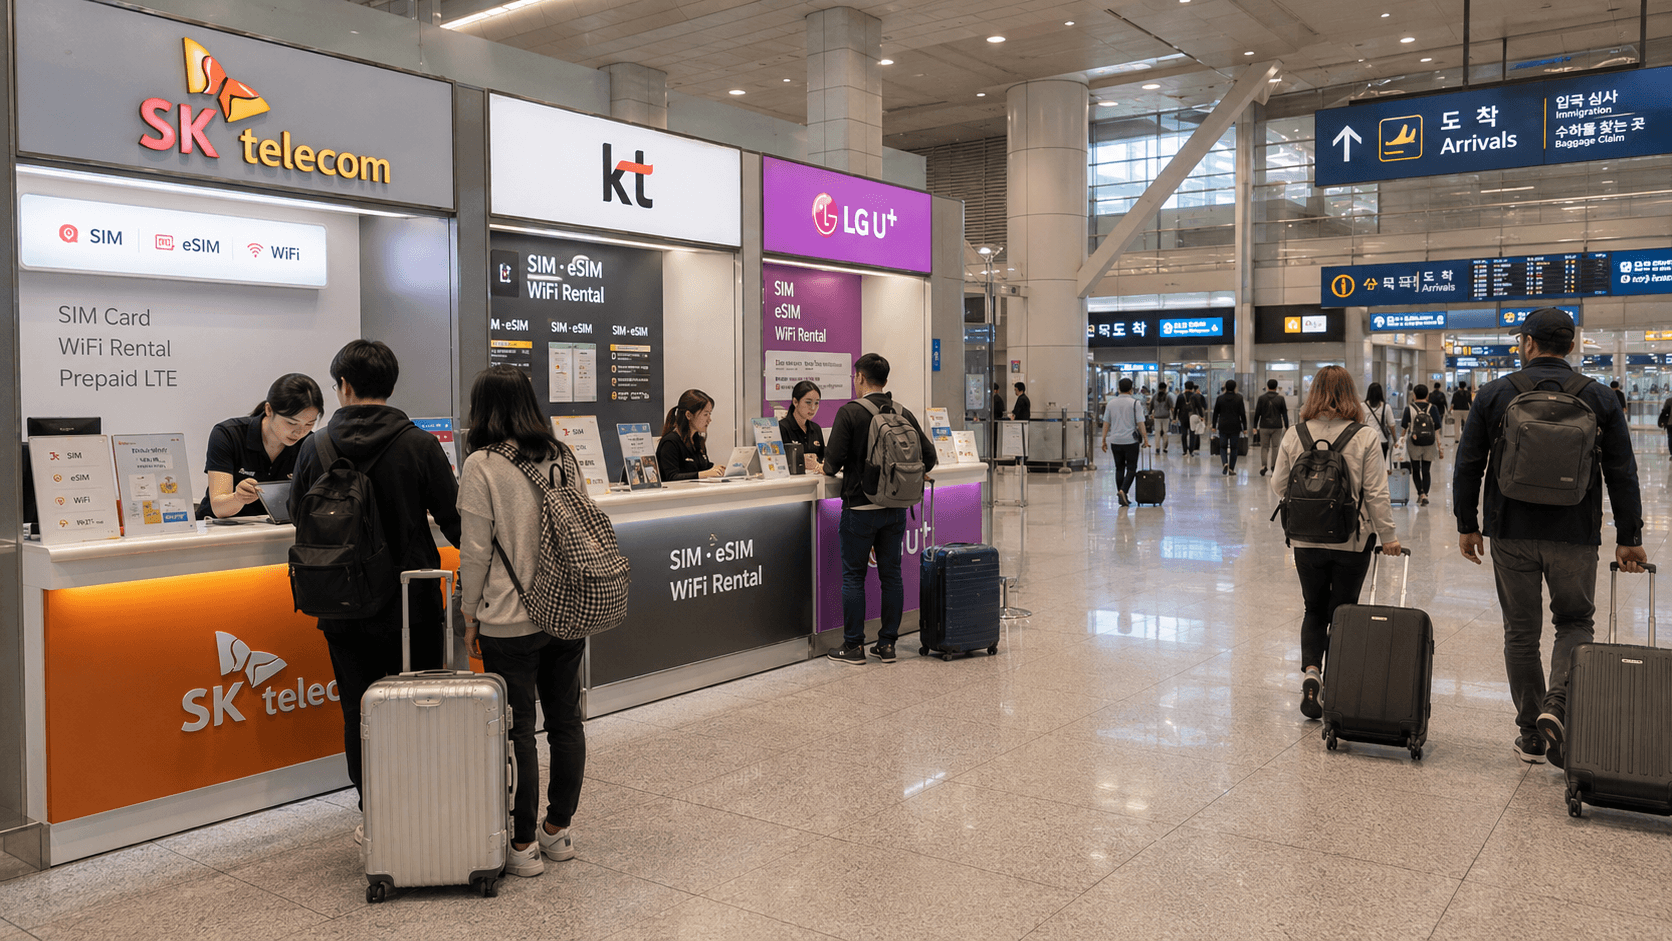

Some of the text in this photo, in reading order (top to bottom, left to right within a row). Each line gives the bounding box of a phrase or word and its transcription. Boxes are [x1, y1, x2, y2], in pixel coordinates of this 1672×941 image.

[1588, 89, 1618, 106] 심사
[1630, 117, 1646, 131] 곳
[138, 97, 391, 184] SK telecom
[1439, 131, 1518, 155] Arrivals
[1555, 138, 1596, 149] Baggage
[602, 142, 654, 209] kt
[843, 205, 898, 239] LG U+
[90, 228, 300, 262] SIM eSIM WiFi
[527, 254, 603, 279] SIM eSIM
[527, 280, 605, 304] WiFi Rental
[774, 280, 794, 298] SIM
[1421, 283, 1456, 293] Arrivals
[58, 305, 151, 327] SIM Card
[774, 303, 801, 320] eSIM
[505, 319, 529, 332] eSIM
[551, 321, 593, 335] SIM eSIM
[612, 325, 649, 337] SIM eSIM
[774, 326, 827, 343] WiFi Rental
[58, 337, 171, 357] WiFi Rental
[60, 369, 178, 391] Prepaid LTE
[67, 452, 82, 460] SIM
[70, 474, 90, 482] eSIM
[73, 496, 91, 504] WiFi
[669, 539, 754, 571] SIM eSIM
[669, 564, 763, 602] WiFi Rental
[181, 681, 246, 732] SK
